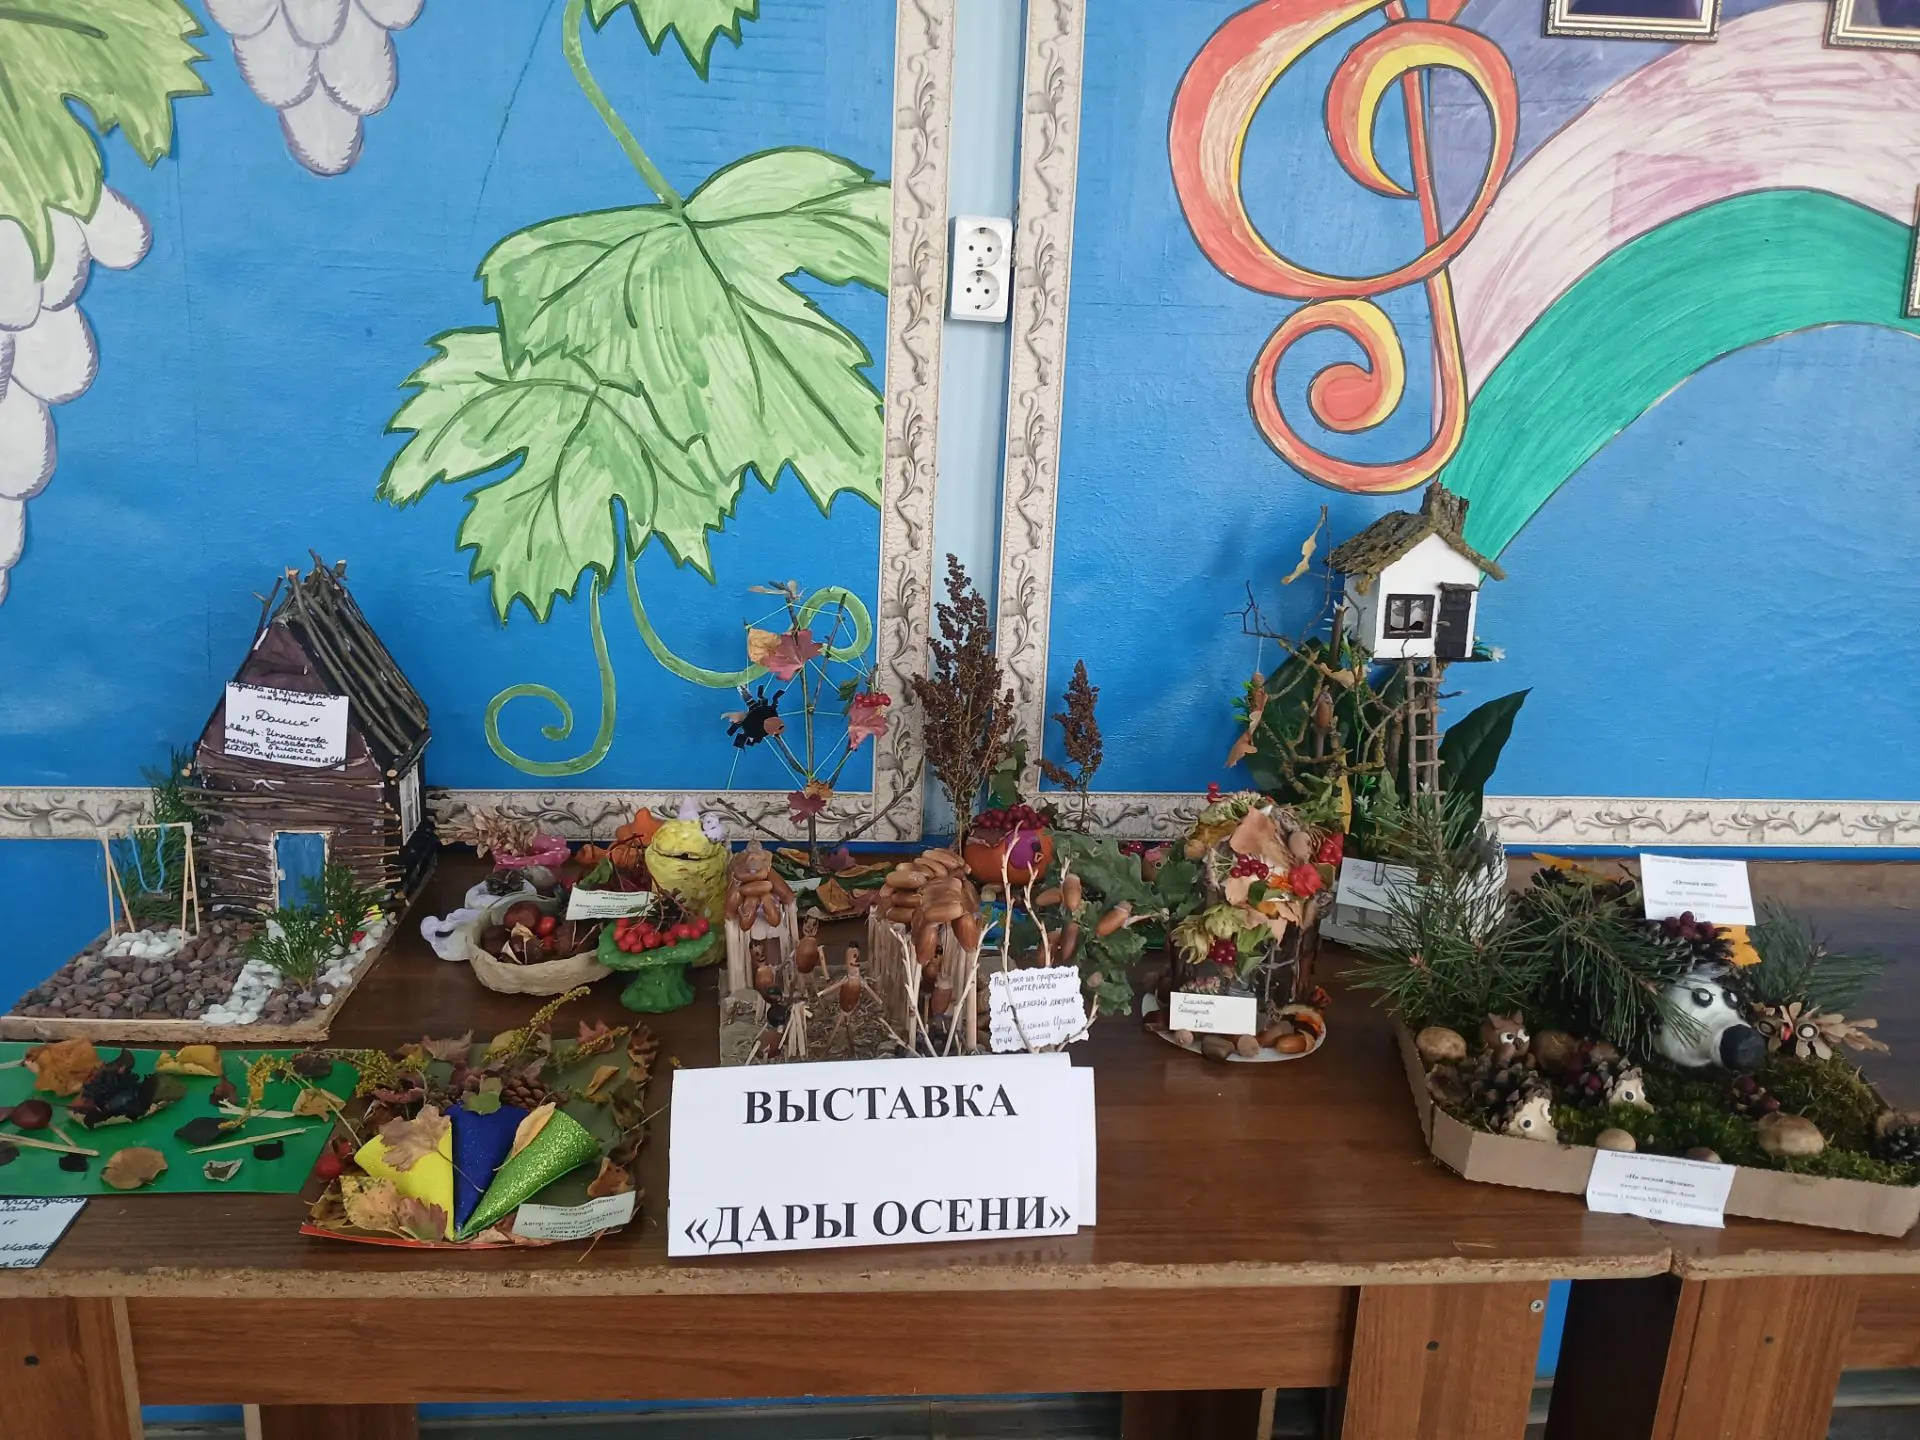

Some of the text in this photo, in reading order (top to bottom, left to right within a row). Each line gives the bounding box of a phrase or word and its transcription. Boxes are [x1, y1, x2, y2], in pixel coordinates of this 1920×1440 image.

[742, 1083, 1018, 1125] ВЫСТАВКА
[684, 1196, 1071, 1253] «ДАРЫ ОСЕНИ»
